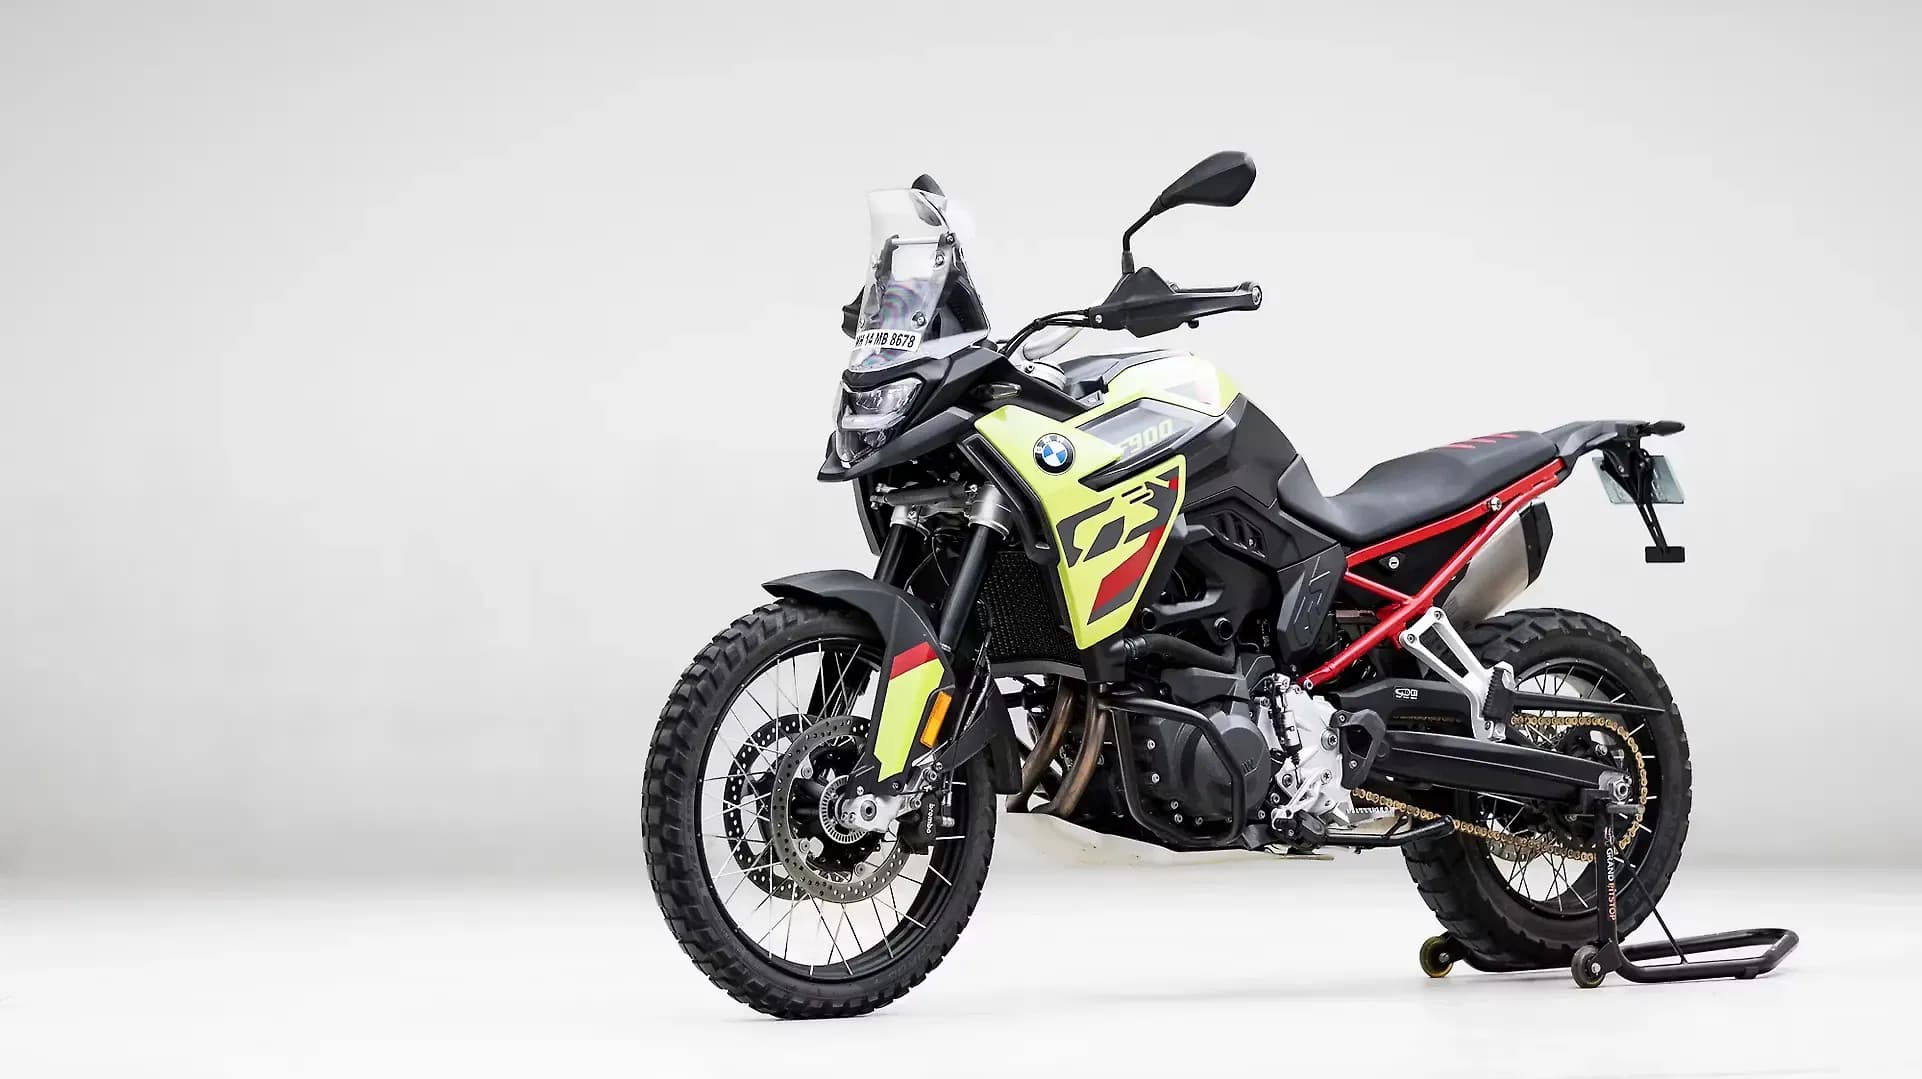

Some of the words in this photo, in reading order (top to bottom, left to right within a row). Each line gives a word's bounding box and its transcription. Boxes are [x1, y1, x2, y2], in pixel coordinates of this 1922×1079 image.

[874, 332, 889, 346] MB
[889, 332, 916, 348] 8678
[926, 803, 936, 834] brembo
[1606, 847, 1615, 882] GRAND
